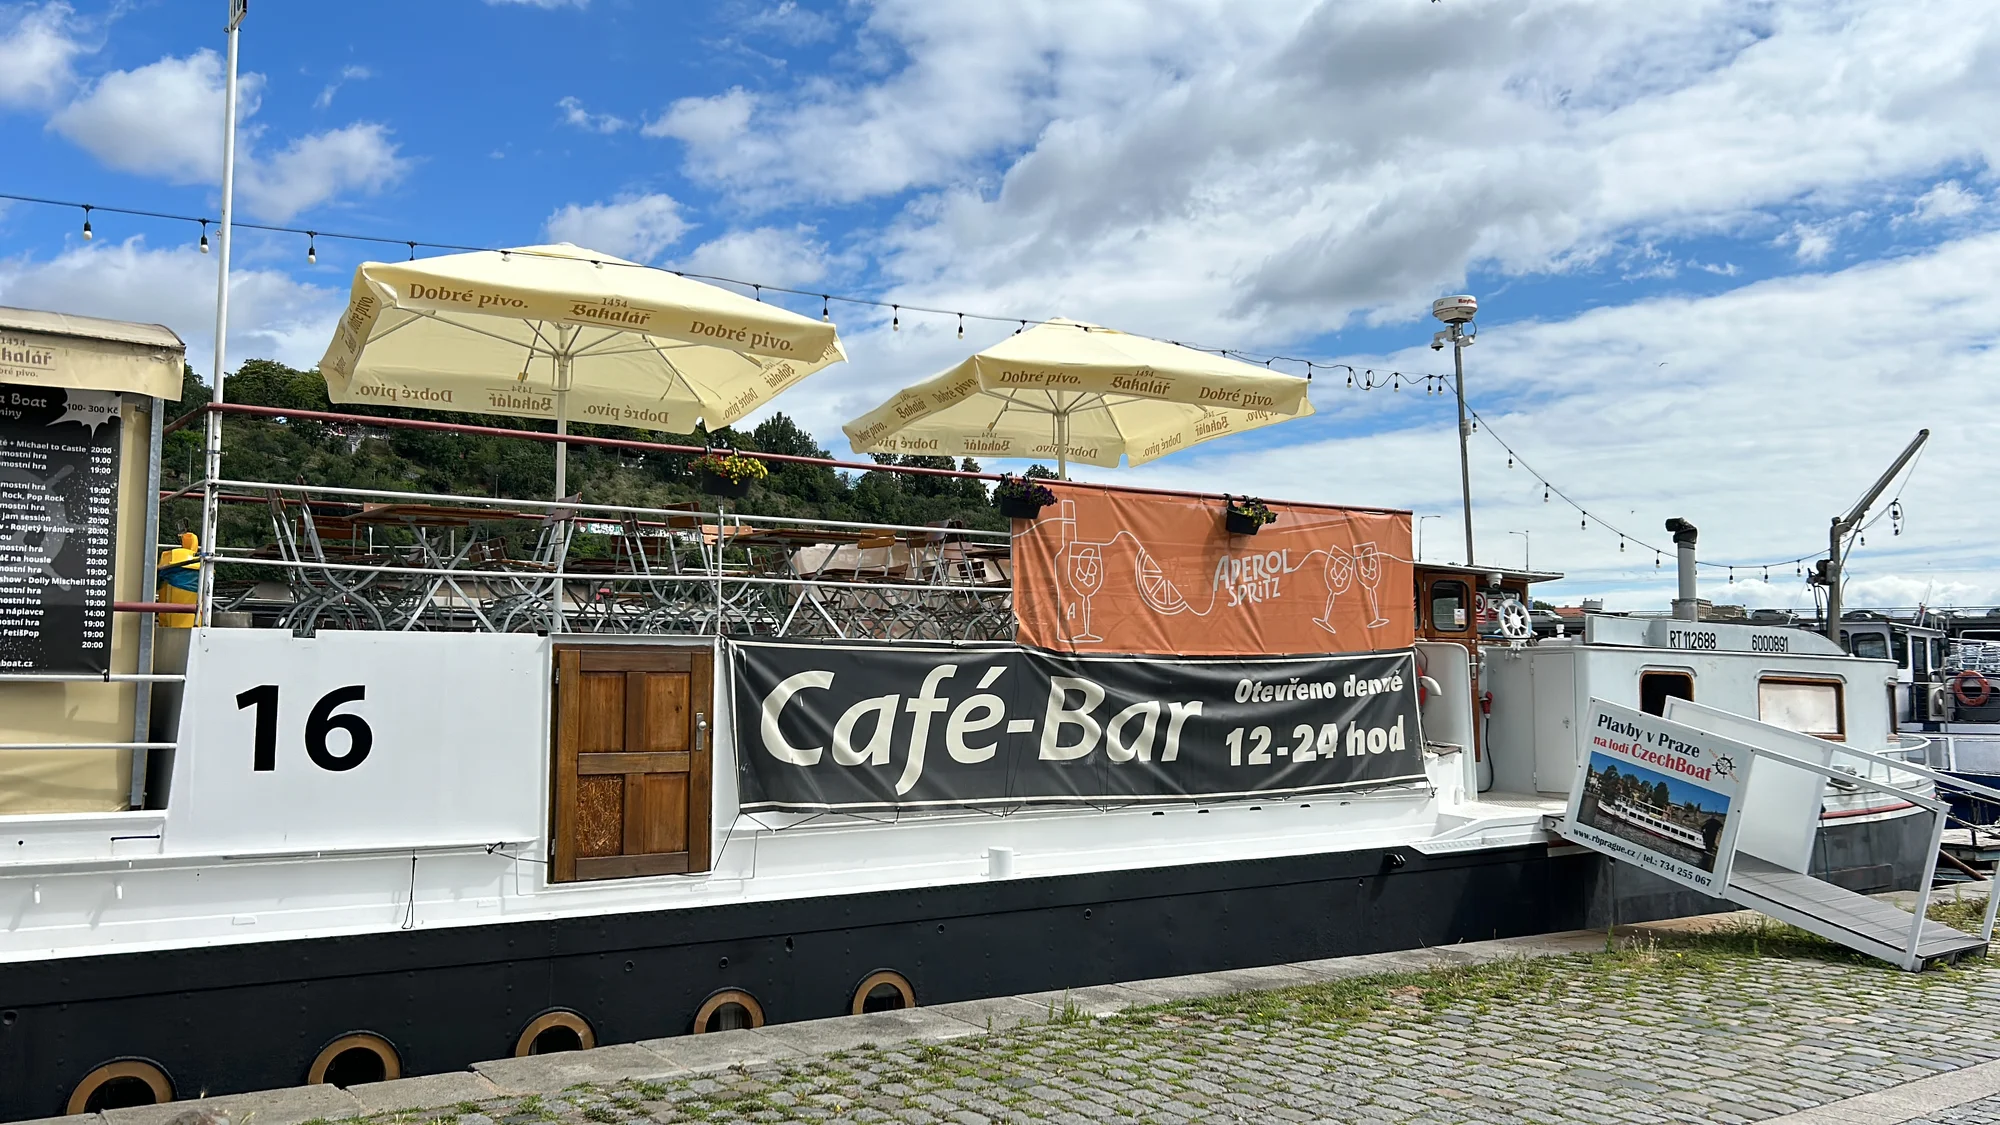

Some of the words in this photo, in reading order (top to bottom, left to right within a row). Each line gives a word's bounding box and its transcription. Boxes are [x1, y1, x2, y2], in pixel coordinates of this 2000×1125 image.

[409, 283, 474, 302] Dobré
[477, 293, 529, 309] pivo.
[601, 297, 628, 309] 1454
[571, 304, 650, 325] Bakalář
[689, 320, 747, 342] Dobré
[750, 333, 794, 352] pivo.
[999, 371, 1045, 383] Dobré
[1045, 372, 1081, 387] pivo.
[1110, 376, 1171, 396] Bakalář
[11, 393, 47, 408] Boat
[1198, 386, 1240, 402] Dobré
[1241, 392, 1274, 407] pivo.
[88, 405, 104, 414] 300
[107, 406, 118, 415] Kč
[17, 440, 49, 450] Michael
[61, 444, 86, 453] Castle
[91, 446, 112, 454] 20:00
[33, 452, 47, 460] hra
[0, 460, 31, 469] mostní
[32, 462, 47, 470] hra
[91, 466, 111, 474] 19:00
[0, 481, 30, 490] mostní
[90, 486, 110, 494] 19:00
[27, 493, 42, 502] Pop
[45, 494, 65, 502] Rock
[89, 496, 110, 505] 19:00
[89, 506, 110, 514] 19:00
[2, 512, 18, 521] jam
[88, 517, 109, 525] 20:00
[87, 527, 109, 535] 20:00
[87, 537, 108, 545] 19:30
[29, 545, 44, 553] hra
[87, 547, 108, 555] 19:00
[23, 555, 51, 564] housle
[86, 557, 108, 566] 20:00
[28, 566, 42, 574] hra
[86, 568, 107, 576] 19:00
[1213, 548, 1293, 592] APEROL
[28, 576, 50, 586] Dolly
[86, 578, 107, 587] 18:00
[27, 587, 42, 595] hra
[85, 589, 107, 597] 19:00
[26, 597, 41, 605] hra
[85, 599, 106, 607] 19:00
[6, 607, 44, 617] náplavce
[84, 609, 106, 617] 14:00
[83, 620, 105, 628] 19:00
[81, 641, 104, 649] 20:00
[1669, 630, 1682, 648] RT
[1684, 631, 1717, 650] 112688
[1752, 634, 1789, 653] 6000891
[0, 659, 34, 668] boat.cz
[1234, 677, 1337, 704] Otevřeno
[235, 684, 373, 772] 16
[760, 663, 1203, 797] Café-Bar
[1225, 723, 1339, 767] 12-24
[1346, 715, 1406, 757] hod
[1597, 713, 1644, 742] Plavby
[1647, 731, 1655, 743] v
[1658, 733, 1700, 758] Praze
[1593, 735, 1607, 748] na
[1631, 743, 1712, 782] CzechBoat
[1573, 828, 1636, 857] www.rbprague.cz
[1660, 860, 1675, 873] 734
[1677, 867, 1693, 881] 255
[1695, 875, 1712, 887] 067
